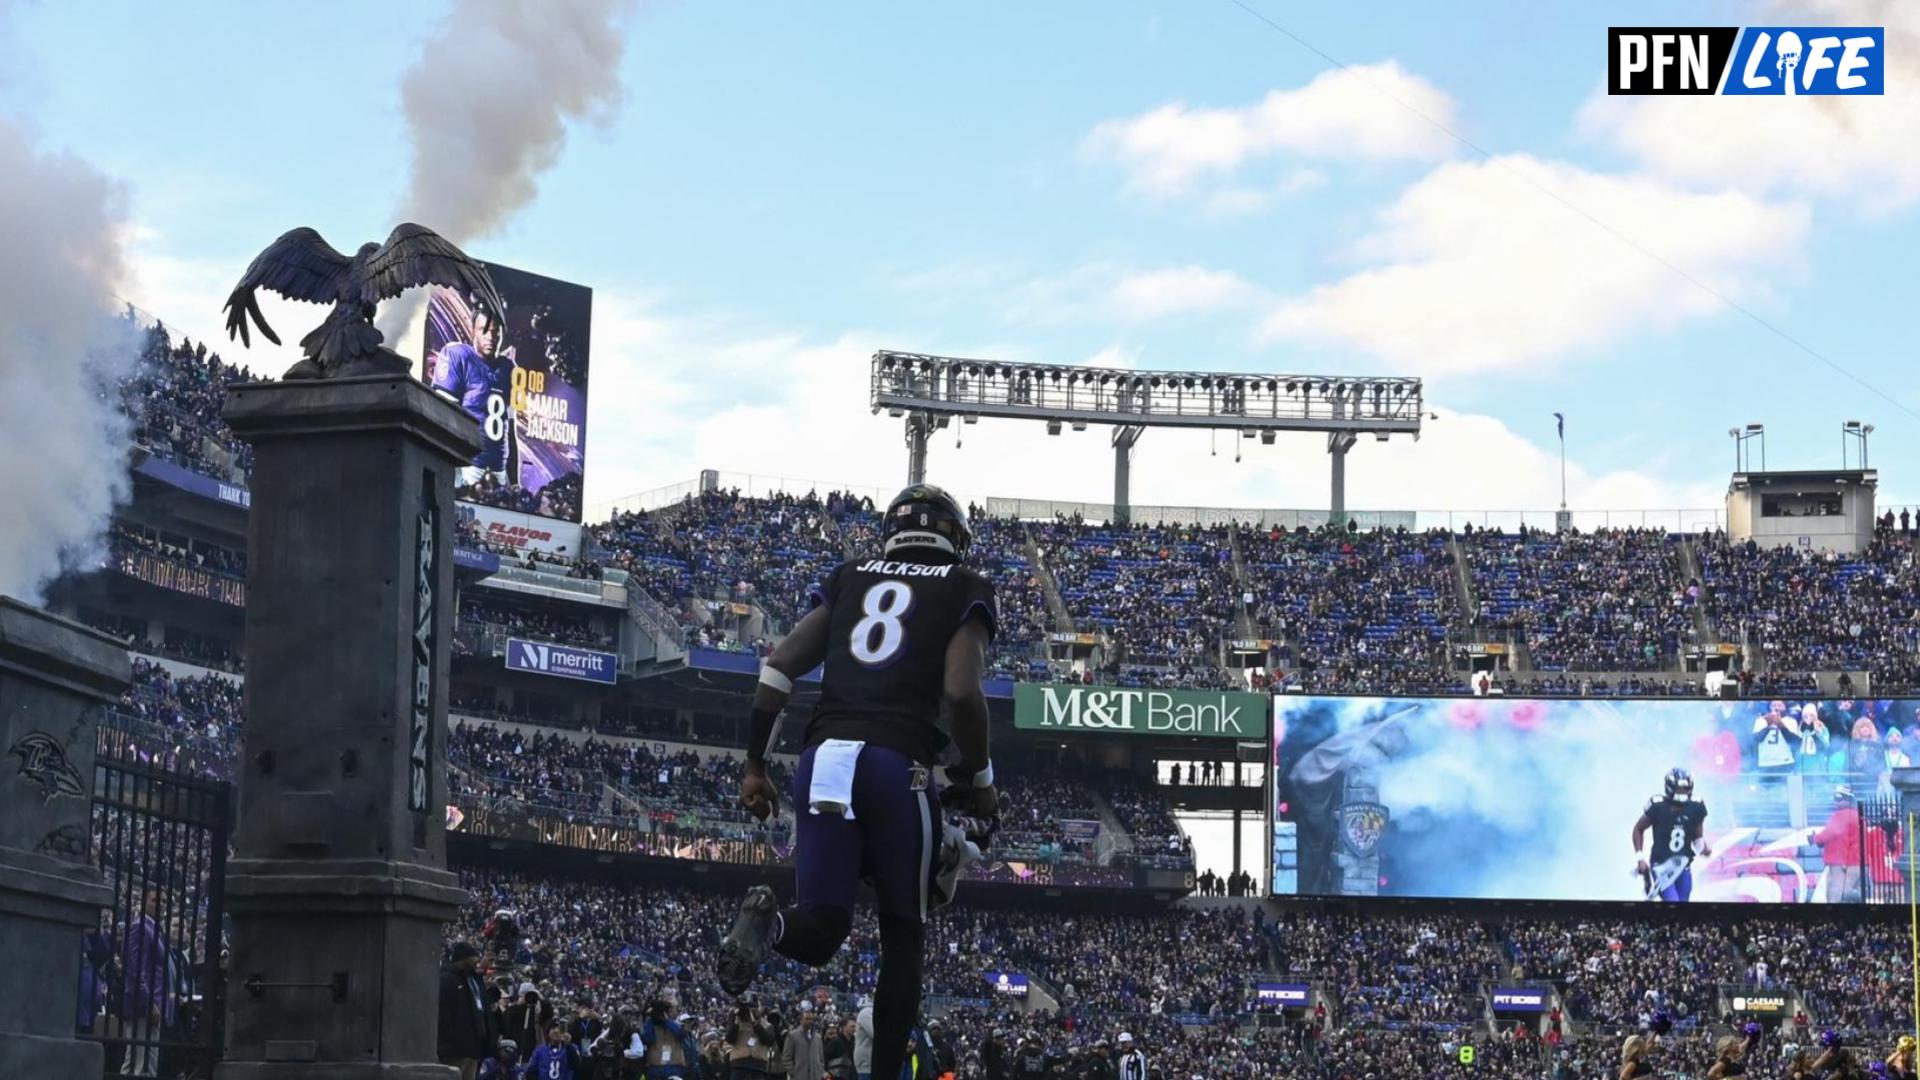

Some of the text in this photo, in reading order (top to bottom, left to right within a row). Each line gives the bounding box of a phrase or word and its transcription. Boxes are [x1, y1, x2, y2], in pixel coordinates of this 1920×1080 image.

[511, 367, 544, 411] 8 QB
[485, 394, 505, 441] 8
[526, 391, 568, 421] LAMAR
[525, 416, 578, 446] JACKSON
[488, 522, 552, 541] FLAVOR
[920, 513, 928, 527] 8
[856, 559, 953, 578] JACKSON
[850, 580, 912, 663] 8
[413, 510, 433, 810] RAVENS
[552, 651, 603, 671] merritt
[1040, 687, 1242, 733] M&T Bank
[1669, 827, 1686, 853] 8
[1746, 997, 1785, 1006] CAESARS
